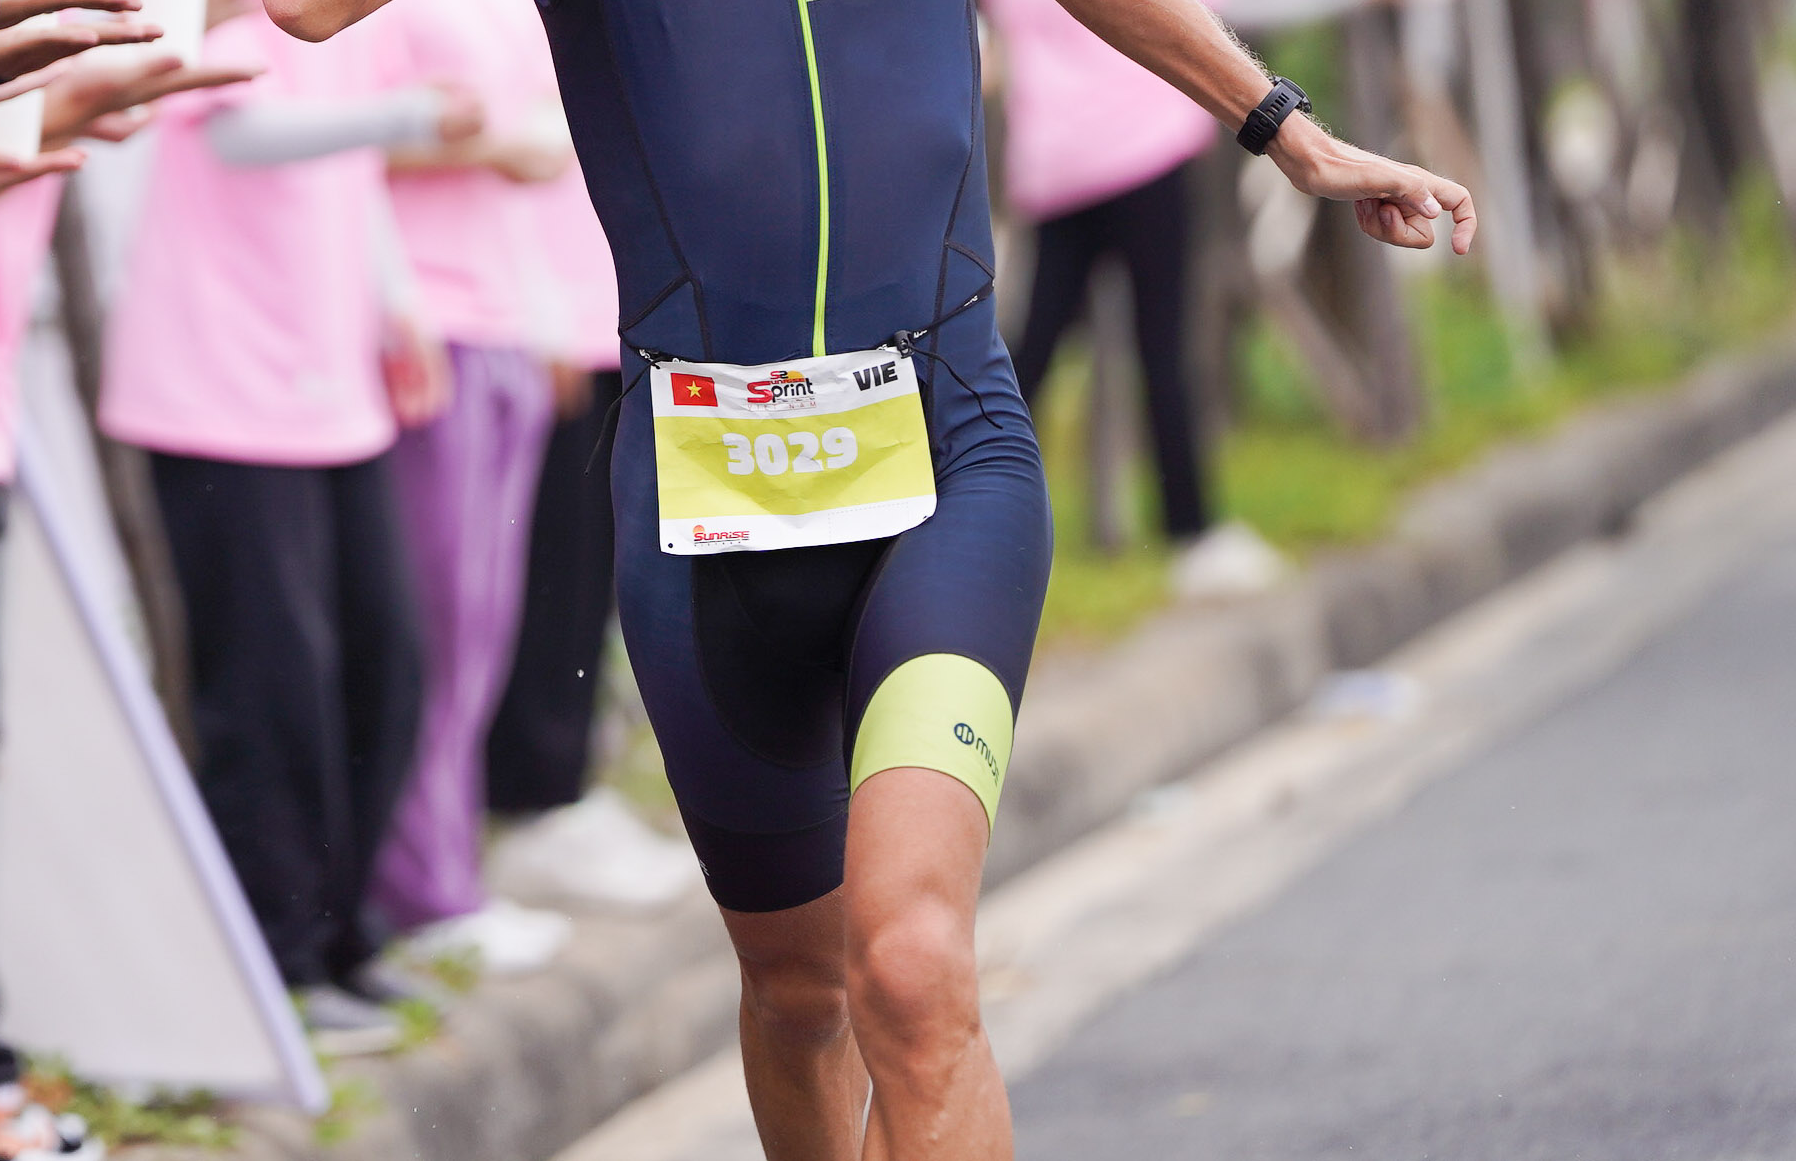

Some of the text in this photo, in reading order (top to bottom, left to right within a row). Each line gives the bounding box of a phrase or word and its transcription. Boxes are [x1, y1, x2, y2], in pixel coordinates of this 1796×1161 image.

[746, 377, 814, 404] Sprint
[853, 361, 898, 391] VIE
[722, 426, 858, 476] 3029
